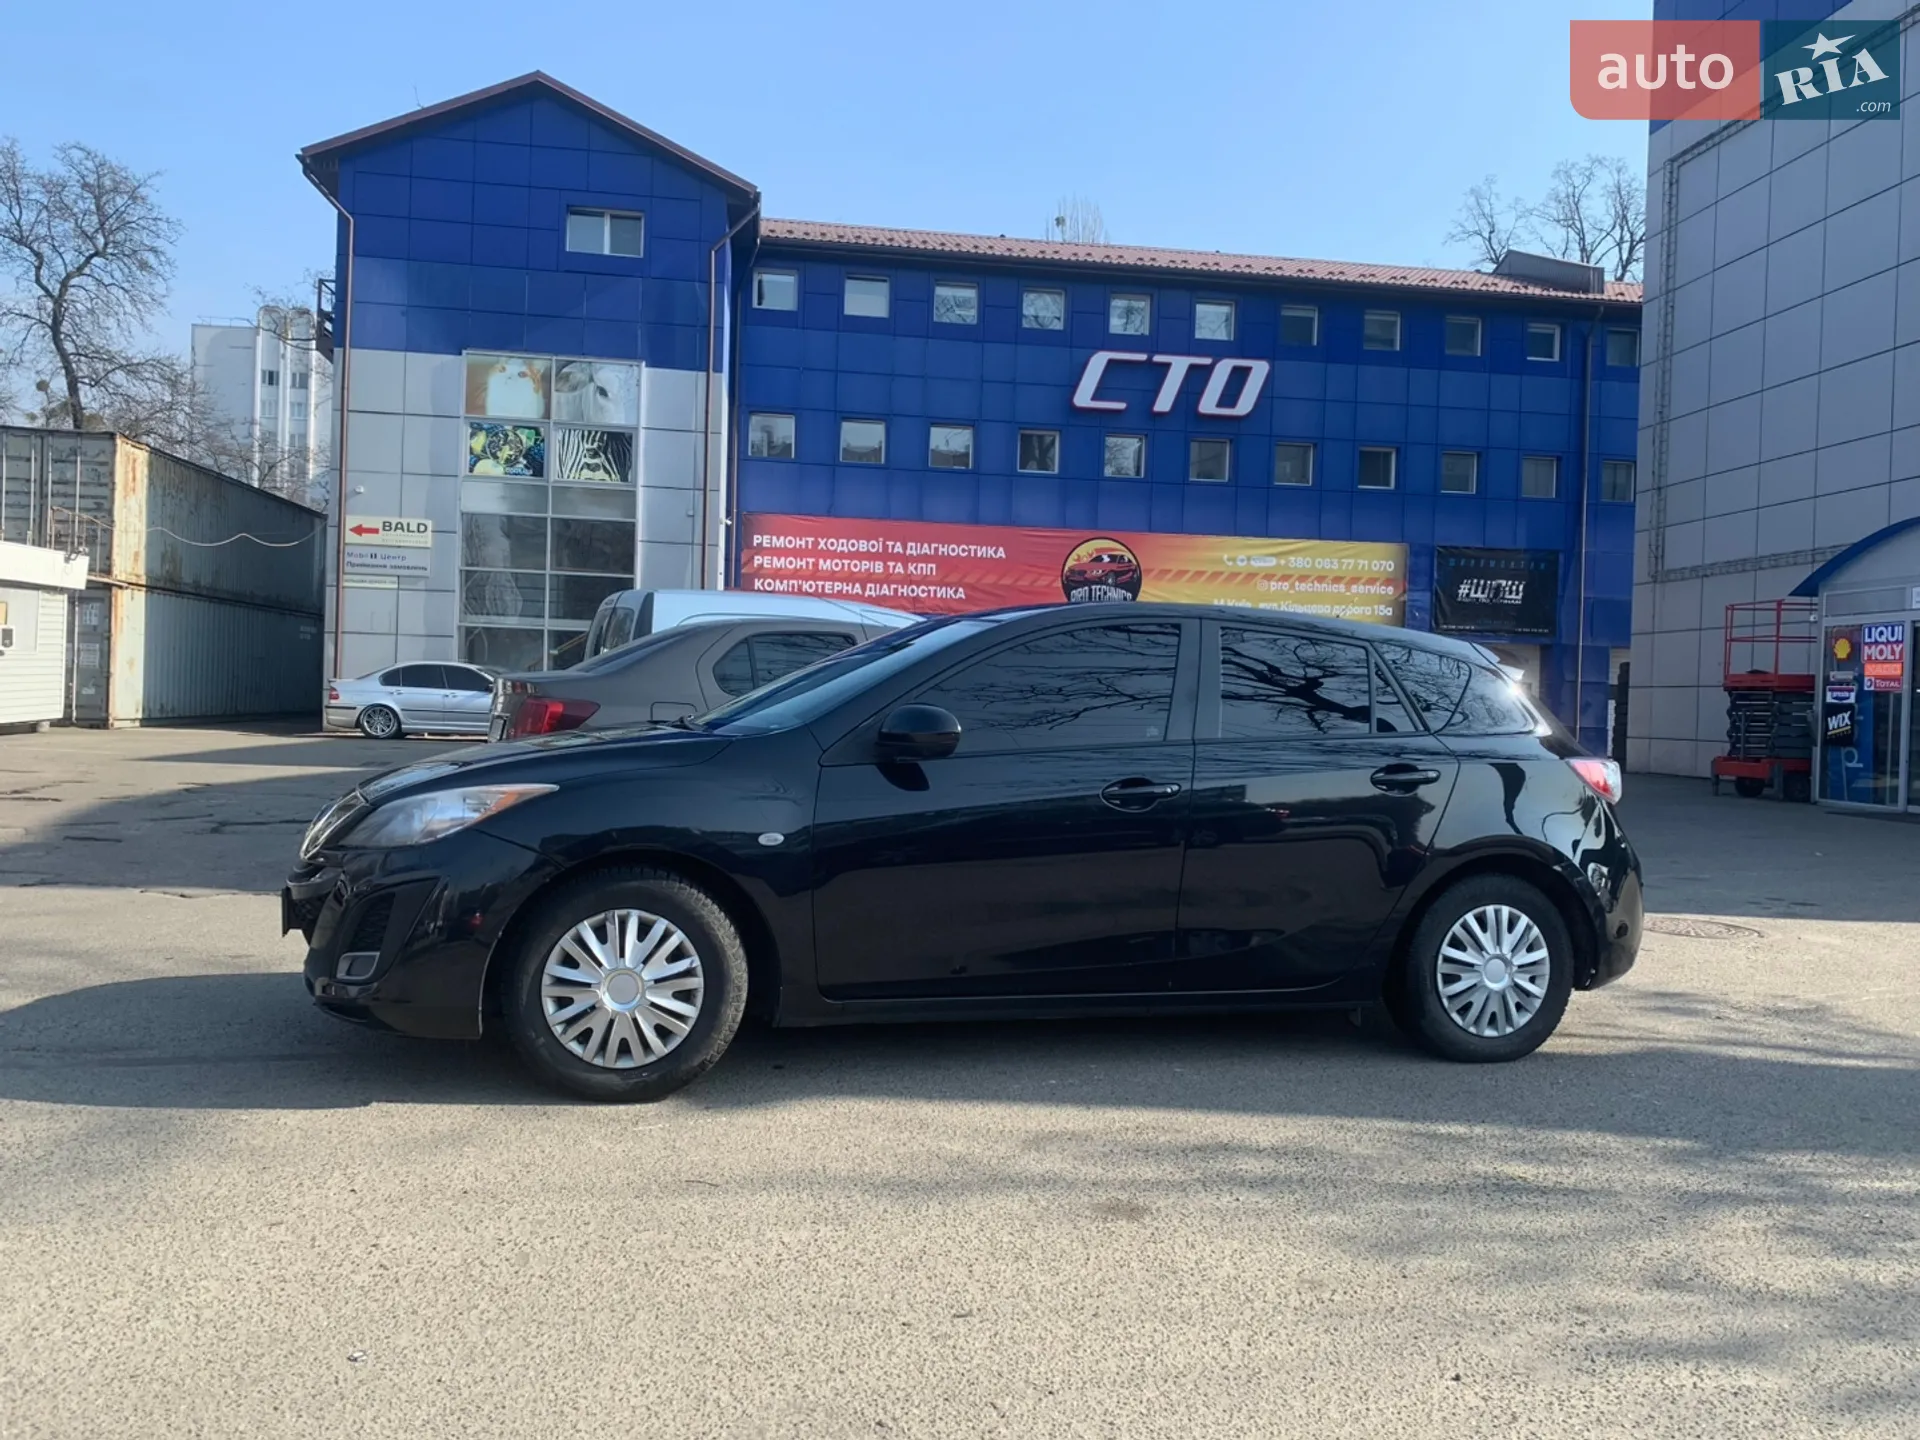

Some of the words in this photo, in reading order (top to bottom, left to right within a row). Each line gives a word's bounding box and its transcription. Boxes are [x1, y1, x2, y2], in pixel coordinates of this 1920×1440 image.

[1072, 350, 1270, 417] СТО
[381, 520, 428, 534] BALD
[753, 534, 815, 549] РЕМОНТ
[818, 537, 884, 553] ХОДОВОЇ
[886, 541, 903, 554] ТА
[906, 542, 1006, 559] ДІАГНОСТИКА
[753, 555, 815, 570] РЕМОНТ
[819, 558, 884, 573] МОТОРІВ
[887, 561, 904, 574] ТА
[908, 563, 936, 576] КПП
[1341, 559, 1355, 570] 77
[1371, 560, 1394, 572] 070
[865, 583, 966, 600] ДІАГНОСТИКА
[1864, 625, 1902, 643] LIQUI
[1864, 644, 1903, 661] MOLY
[1875, 680, 1900, 688] TOTAL
[1827, 711, 1852, 731] WIX
